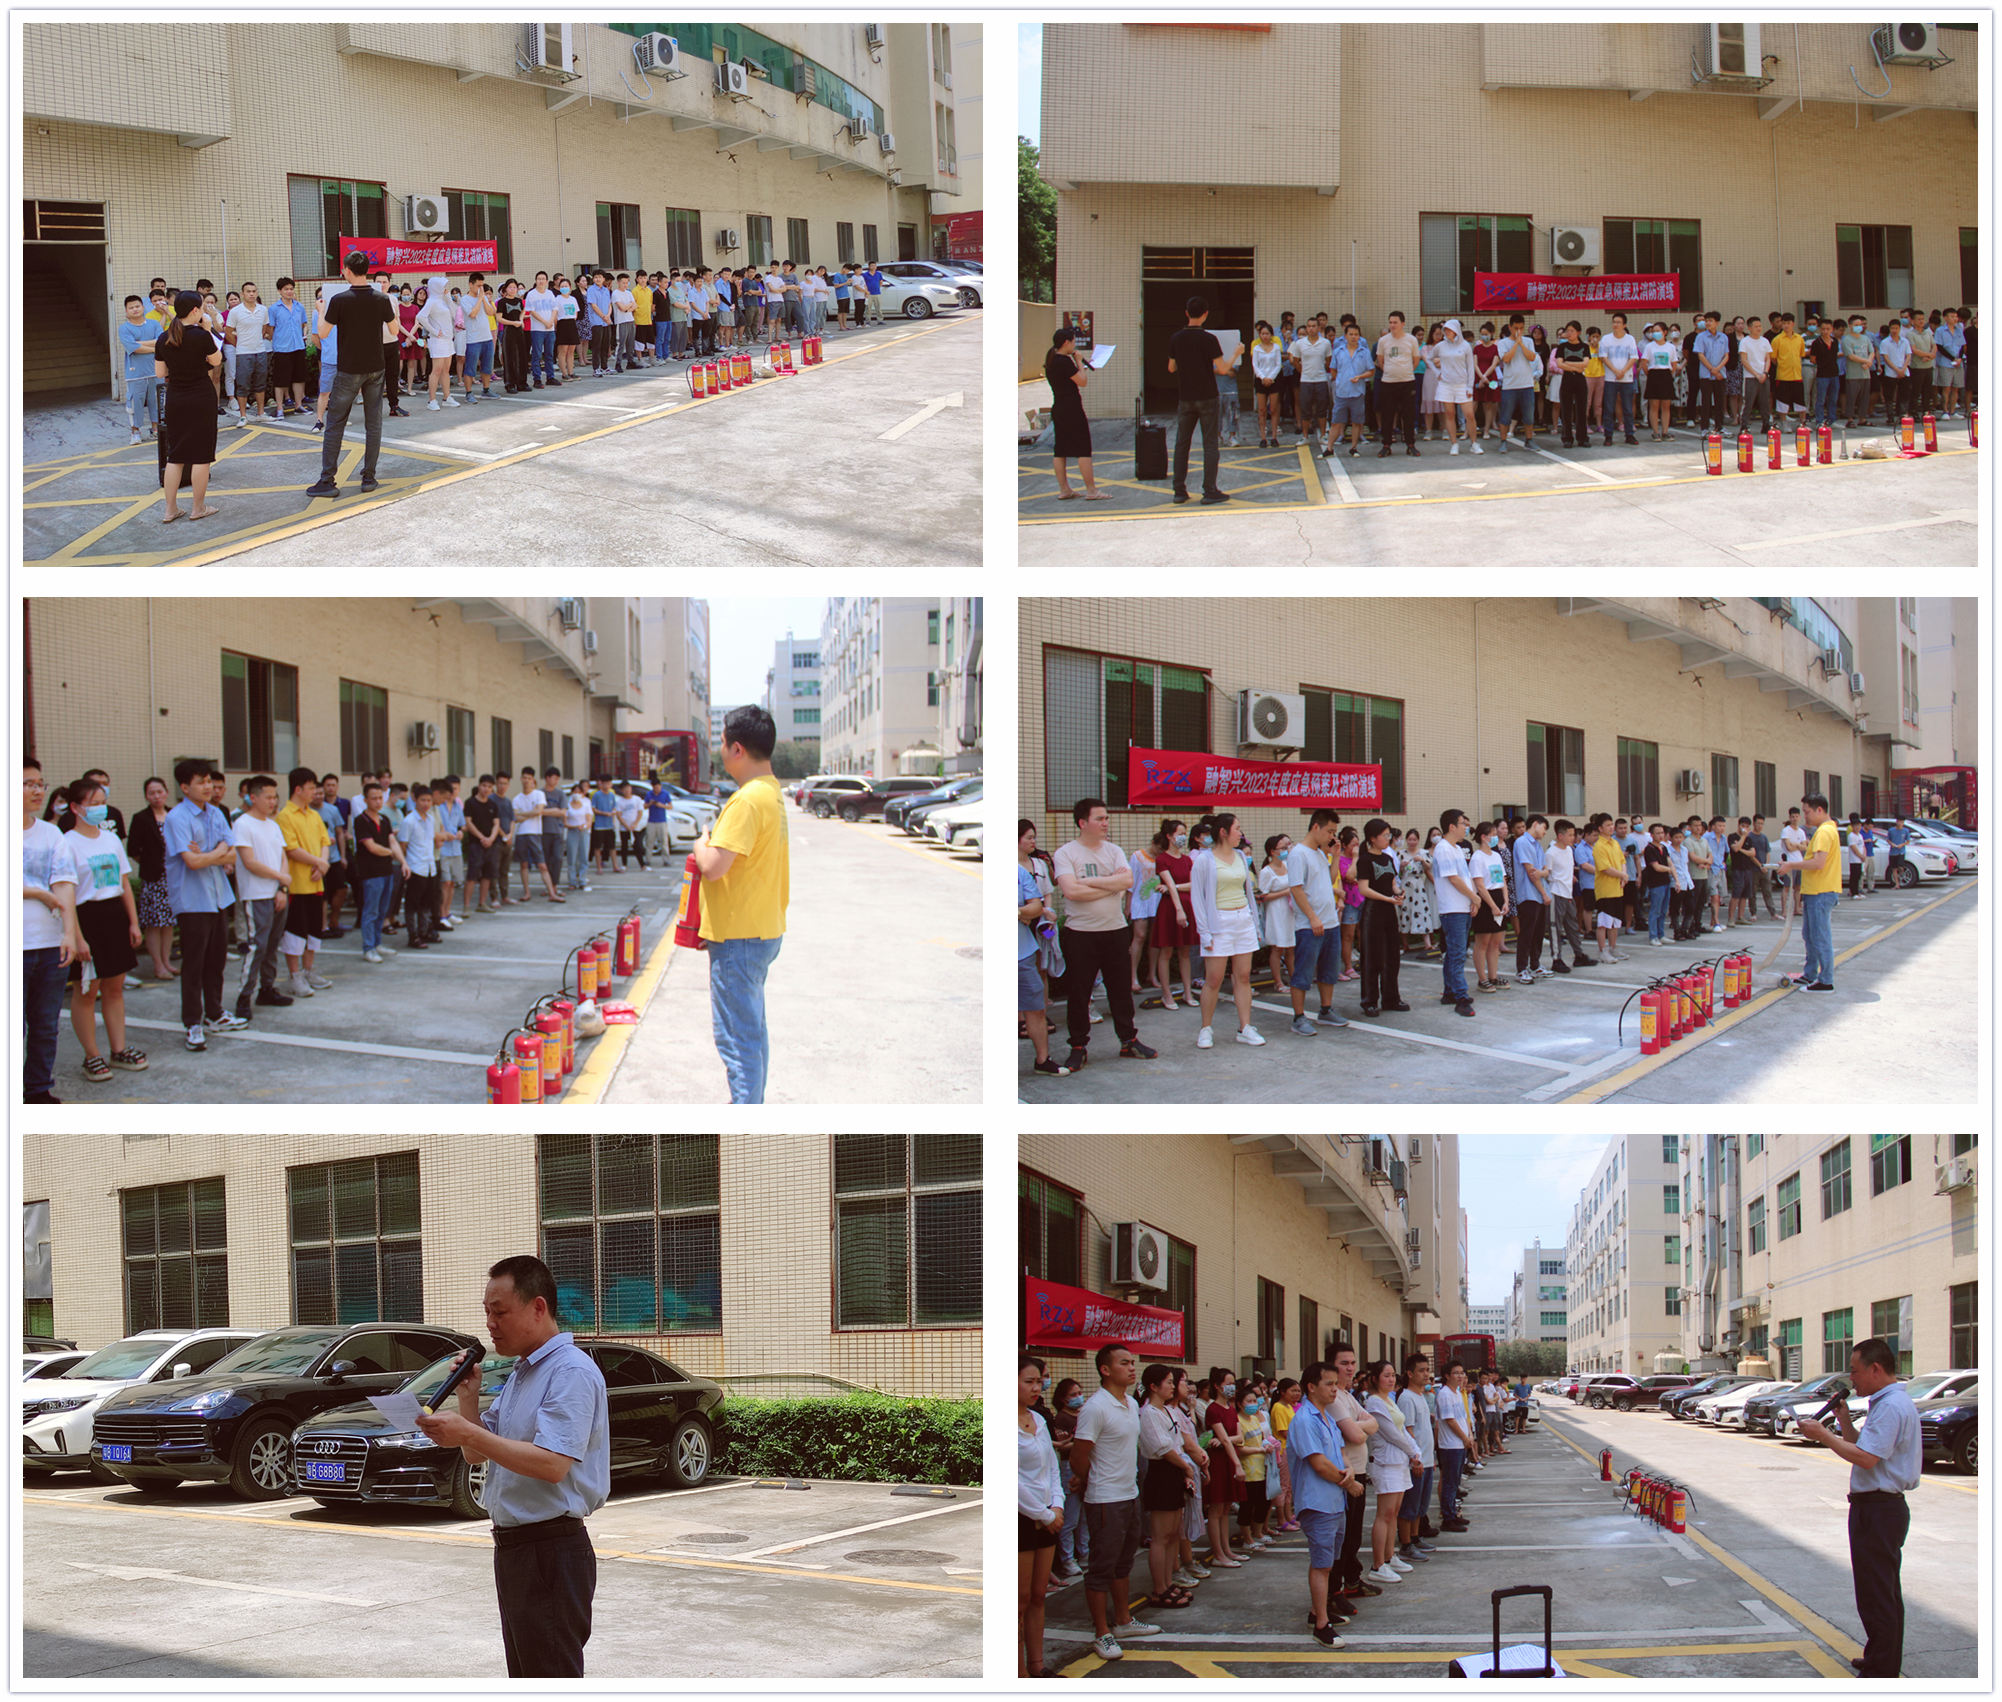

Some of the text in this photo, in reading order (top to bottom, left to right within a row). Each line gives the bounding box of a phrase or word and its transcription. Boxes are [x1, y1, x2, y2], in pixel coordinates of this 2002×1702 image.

[1486, 285, 1518, 297] RZX
[1527, 281, 1674, 301] 融智兴2023年度应急预案及消防演练
[1147, 769, 1192, 785] RZX
[1203, 766, 1377, 799] 融智兴2023年度应急预案及消防演练
[1041, 1303, 1076, 1325] RZX
